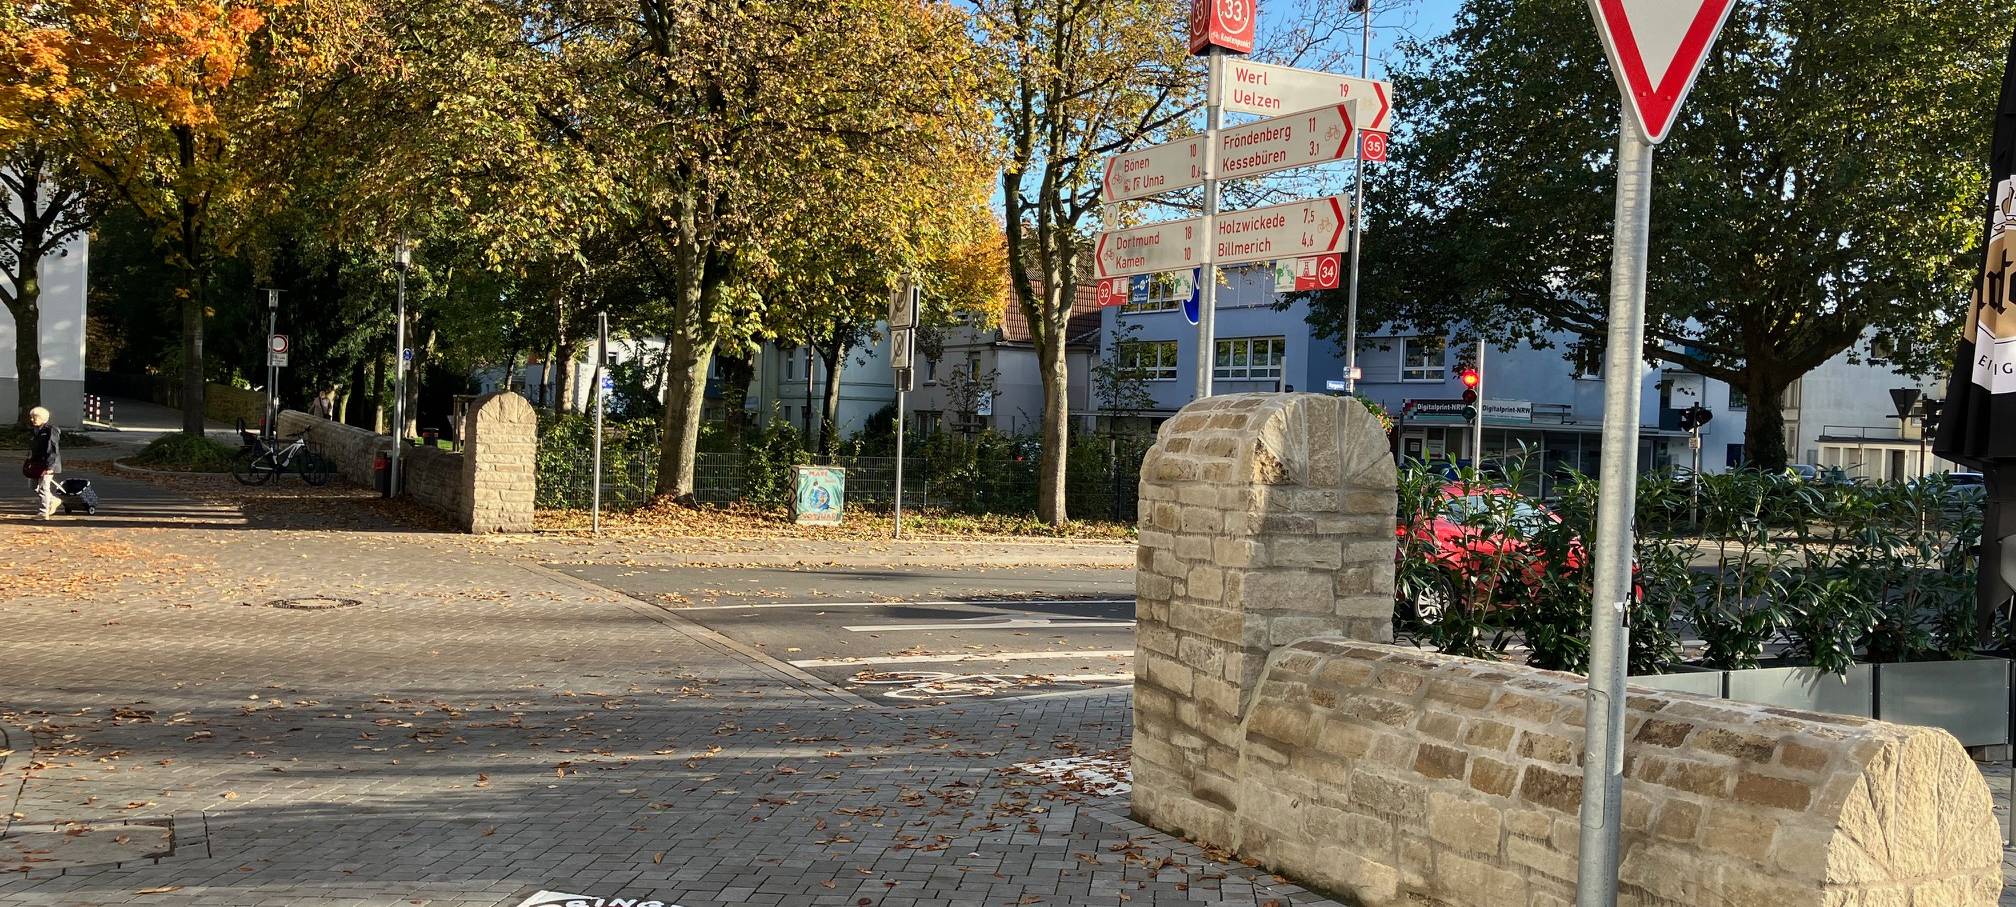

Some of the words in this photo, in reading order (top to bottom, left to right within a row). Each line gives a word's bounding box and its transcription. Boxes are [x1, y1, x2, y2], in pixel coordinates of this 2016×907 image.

[1224, 0, 1243, 22] 33
[1236, 67, 1268, 86] Werl
[1340, 83, 1349, 98] 19
[1234, 89, 1281, 110] Uelzen
[1223, 125, 1292, 150] Fröndenberg
[1309, 117, 1317, 133] 11
[1124, 158, 1150, 173] Bönen
[1190, 143, 1197, 158] 10
[1367, 141, 1380, 153] 35
[1222, 150, 1287, 173] Kessebüren
[1143, 174, 1165, 189] Unna
[1218, 212, 1286, 236] Holzwickede
[1303, 207, 1315, 224] 7,5
[1116, 231, 1160, 250] Dortmund
[1184, 225, 1192, 241] 18
[1217, 237, 1271, 258] Billmerich
[1301, 231, 1314, 248] 4,6
[1115, 255, 1145, 270] Kamen
[1184, 247, 1192, 261] 10
[1321, 266, 1334, 279] 34
[1100, 288, 1109, 299] 32
[1417, 402, 1467, 413] Digitalprint-NRW
[1482, 404, 1531, 414] Digitalprint-NRW
